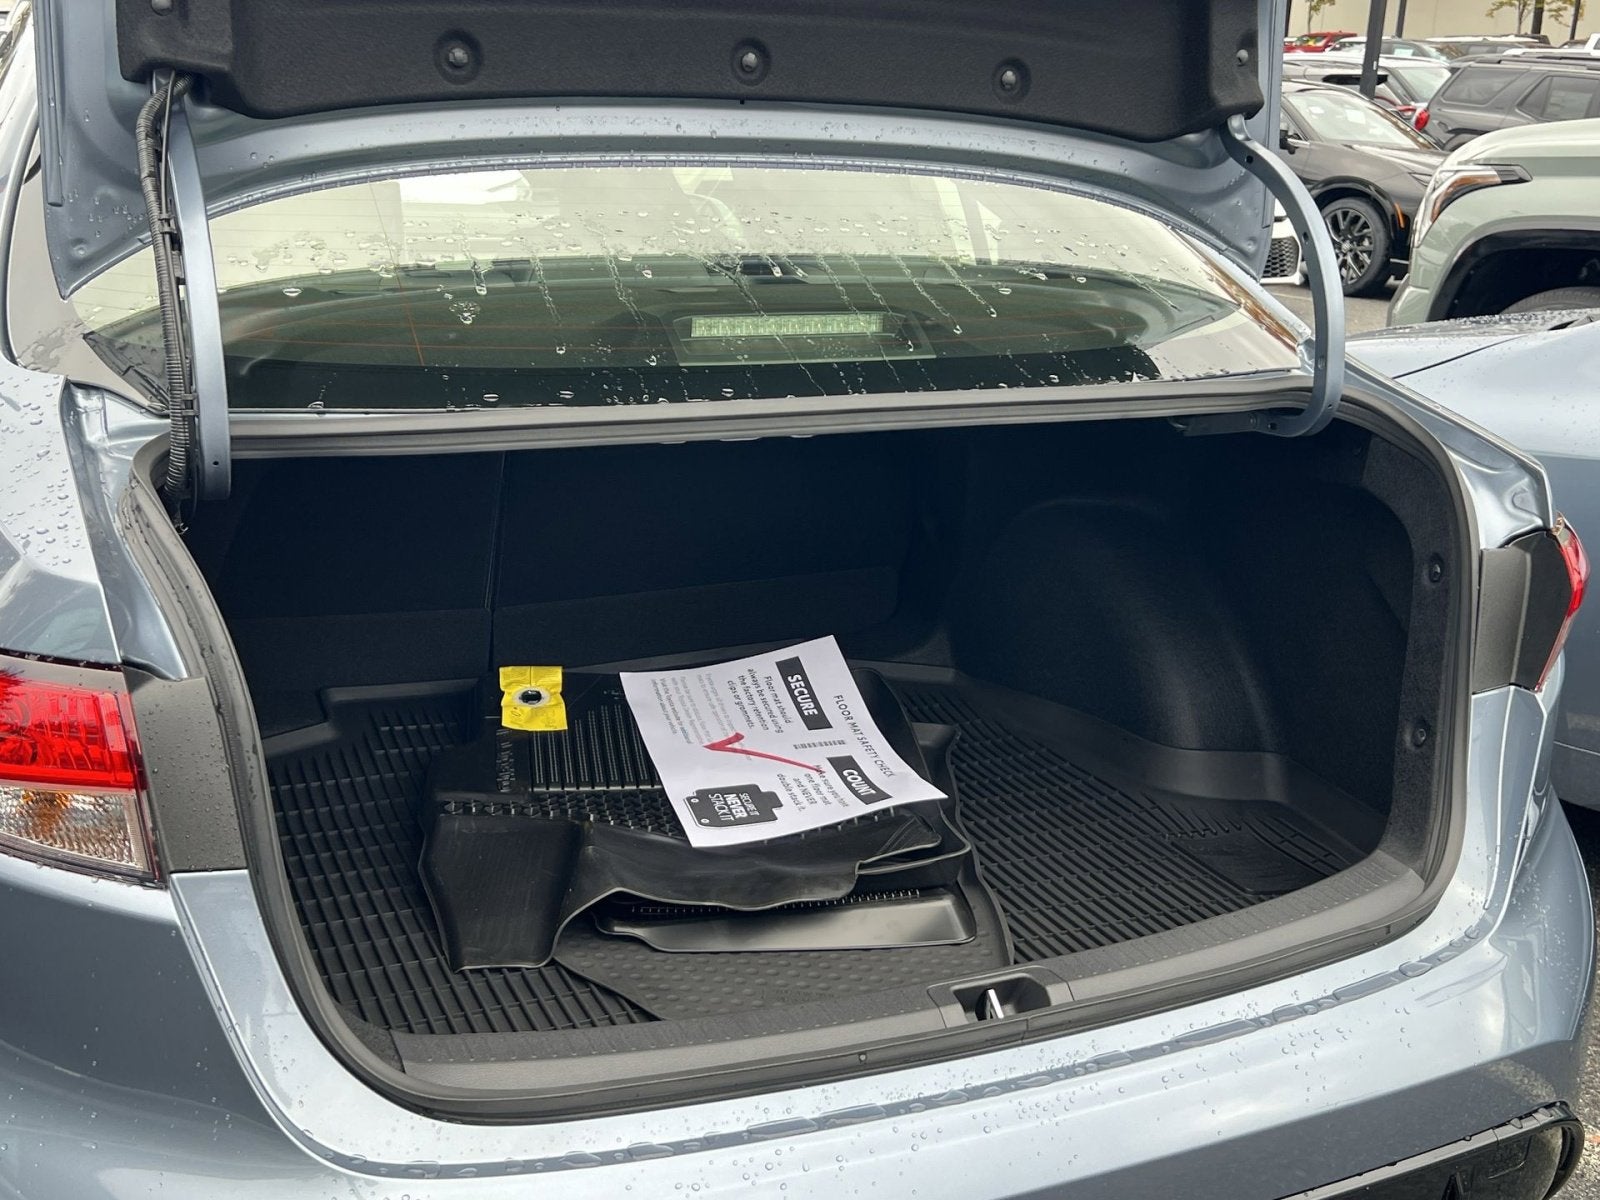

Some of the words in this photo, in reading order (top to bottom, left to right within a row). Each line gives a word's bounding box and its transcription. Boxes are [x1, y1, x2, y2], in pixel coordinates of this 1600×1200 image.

[726, 680, 738, 693] clips
[737, 675, 747, 685] the
[741, 685, 755, 705] factory
[746, 668, 762, 689] always
[759, 697, 777, 718] secured
[769, 718, 784, 733] using
[763, 675, 775, 692] Floor
[771, 693, 781, 704] mat
[776, 704, 793, 723] should
[787, 674, 818, 715] SECURE
[752, 706, 769, 730] retention
[833, 694, 853, 720] FLOOR
[847, 722, 863, 735] MAT
[856, 736, 880, 758] SAFETY
[873, 759, 894, 777] CHECK
[792, 777, 804, 787] and
[799, 788, 817, 804] NEVER
[840, 769, 876, 795] COUNT
[707, 793, 730, 815] STACK
[723, 793, 748, 818] NEVER
[738, 792, 756, 811] SECURE
